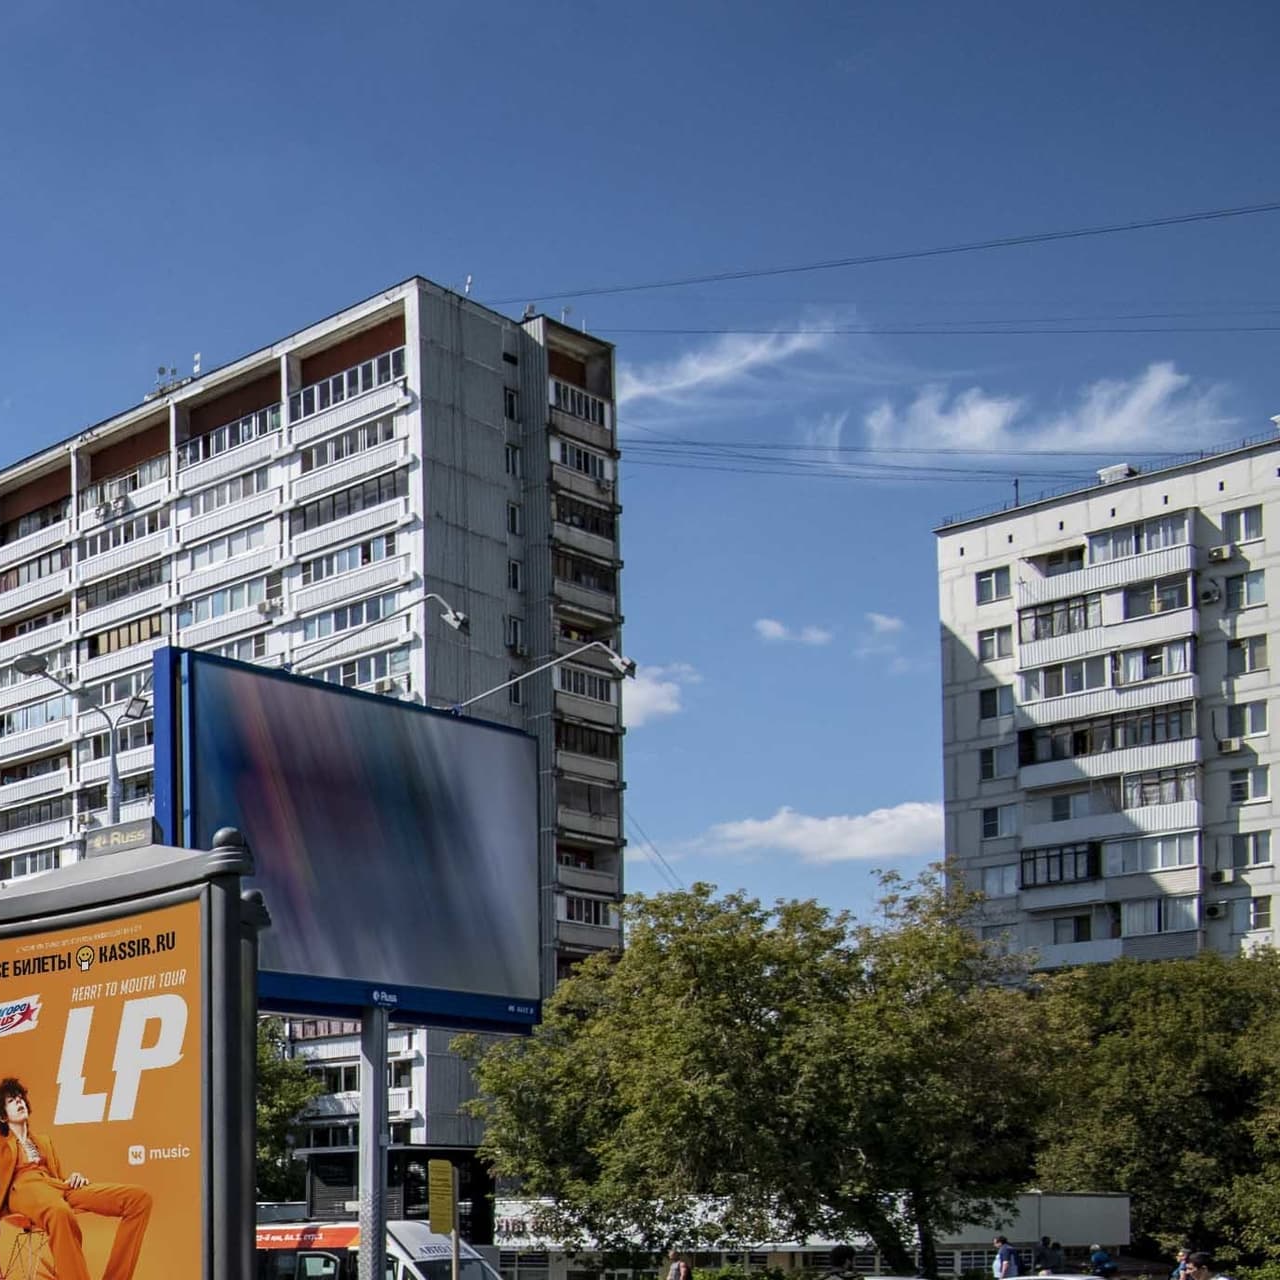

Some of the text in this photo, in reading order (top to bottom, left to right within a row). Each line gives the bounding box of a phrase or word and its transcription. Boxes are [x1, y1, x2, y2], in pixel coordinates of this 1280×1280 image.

[110, 830, 145, 846] Russ
[13, 952, 72, 977] БИЛЕТЫ
[98, 931, 176, 964] KASSIR.RU
[71, 968, 187, 1002] HEART TO MOUTH TOUR
[54, 993, 189, 1125] LP
[149, 1143, 191, 1160] music
